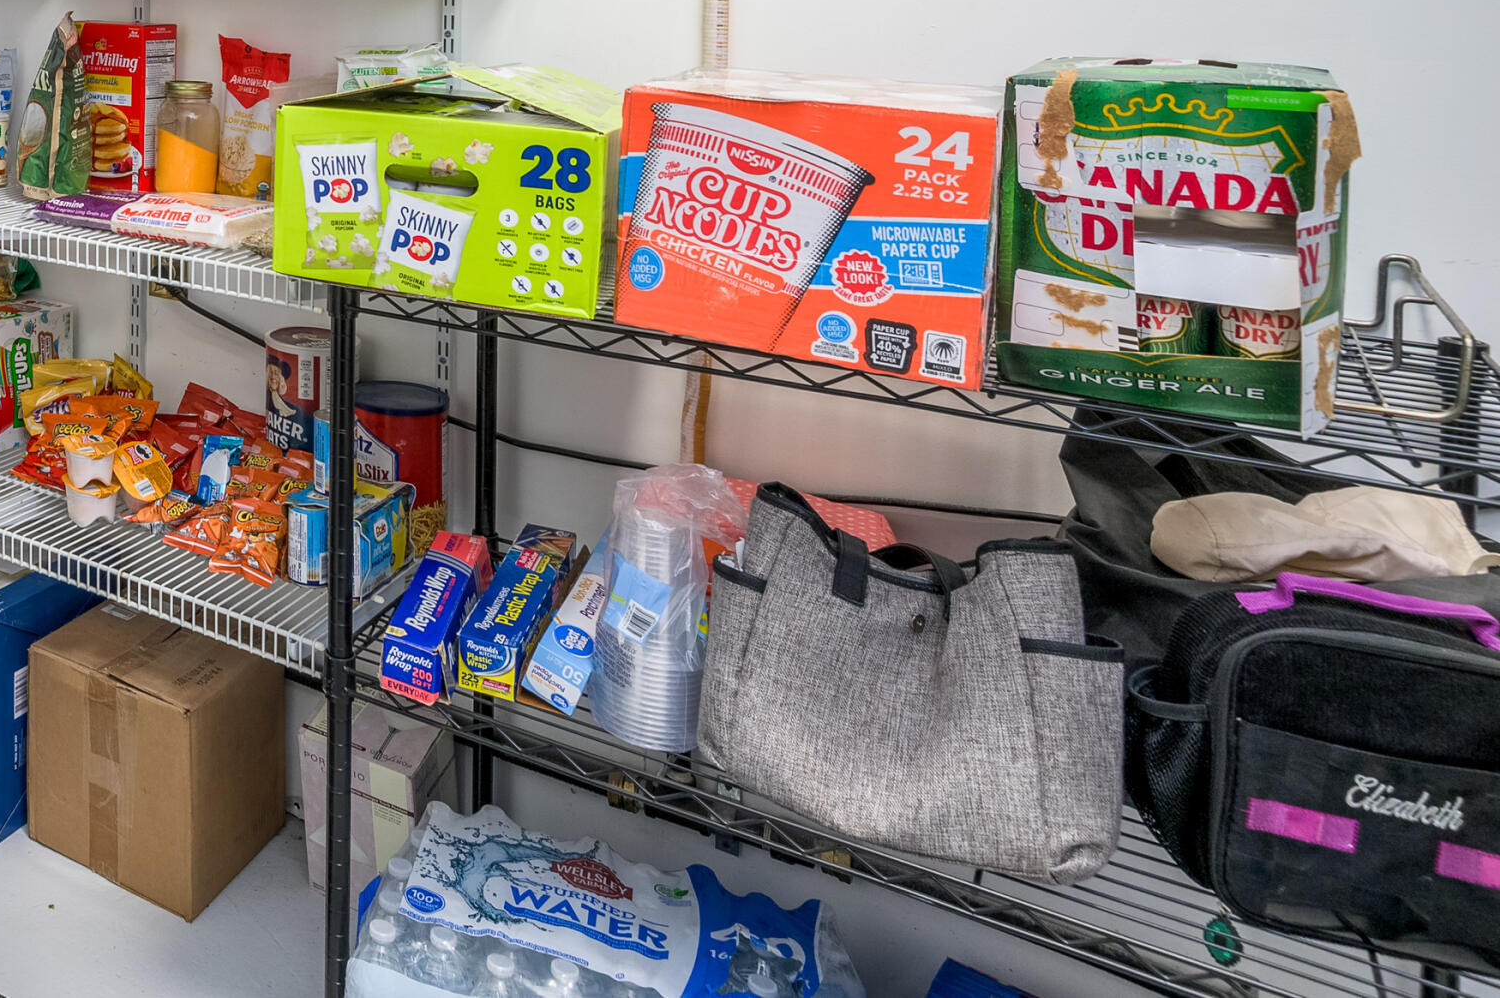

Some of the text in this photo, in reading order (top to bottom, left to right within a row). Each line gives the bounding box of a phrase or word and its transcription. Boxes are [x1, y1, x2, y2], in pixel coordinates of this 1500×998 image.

[95, 51, 139, 73] Milling
[230, 74, 272, 89] ARROWHEA
[894, 125, 974, 171] 24
[729, 146, 776, 171] NISSIN
[1116, 151, 1219, 168] SINCE 1904
[519, 144, 592, 194] 28
[903, 169, 960, 188] PACK
[313, 178, 368, 204] POP
[687, 167, 791, 224] CUP
[892, 183, 970, 205] 2.25 OZ
[1077, 160, 1299, 216] ANADA
[535, 194, 576, 212] BAGS
[330, 220, 357, 228] ORIGINAL
[645, 187, 801, 271] NOODLES
[871, 225, 967, 243] MICROWAVABLE
[390, 229, 450, 266] POP
[881, 243, 960, 259] PAPER CUP
[630, 264, 658, 274] ADDED
[636, 255, 650, 265] NO
[656, 232, 776, 291] CHICKEN FLAVOR
[846, 260, 873, 272] NEW
[398, 272, 426, 288] ORIGINAL
[843, 273, 879, 285] LOOK!
[904, 264, 926, 278] 2:15
[853, 292, 874, 304] GREAT
[823, 324, 847, 333] ADDED
[873, 323, 910, 336] PAPER CUP
[877, 340, 902, 353] 40%
[15, 342, 32, 391] LL-UPS
[880, 356, 897, 364] PAPER
[1039, 368, 1266, 401] GINGER ALE
[1076, 366, 1223, 384] CAFFEINE FREE
[267, 412, 304, 442] AKER
[266, 428, 289, 450] ATS
[404, 566, 457, 633] Reynolds Wrap
[495, 572, 545, 626] Plastic Wrap
[466, 639, 499, 656] Reynolds
[559, 628, 581, 650] Great
[385, 654, 412, 673] Wrap
[388, 645, 434, 670] Reynolds
[466, 652, 493, 665] Plastic
[466, 658, 488, 671] Wrap
[411, 677, 432, 690] SQ FT
[412, 667, 433, 682] 200
[461, 671, 480, 684] 225
[461, 679, 470, 687] SQ
[531, 669, 566, 693] Parchment
[562, 665, 585, 685] 50
[387, 679, 430, 702] EVERYDAY
[1344, 773, 1467, 832] Elizabeth
[556, 863, 628, 895] WELLSLEY
[411, 889, 440, 903] 100%
[541, 883, 636, 921] PURIFIED
[509, 885, 669, 951] WATER
